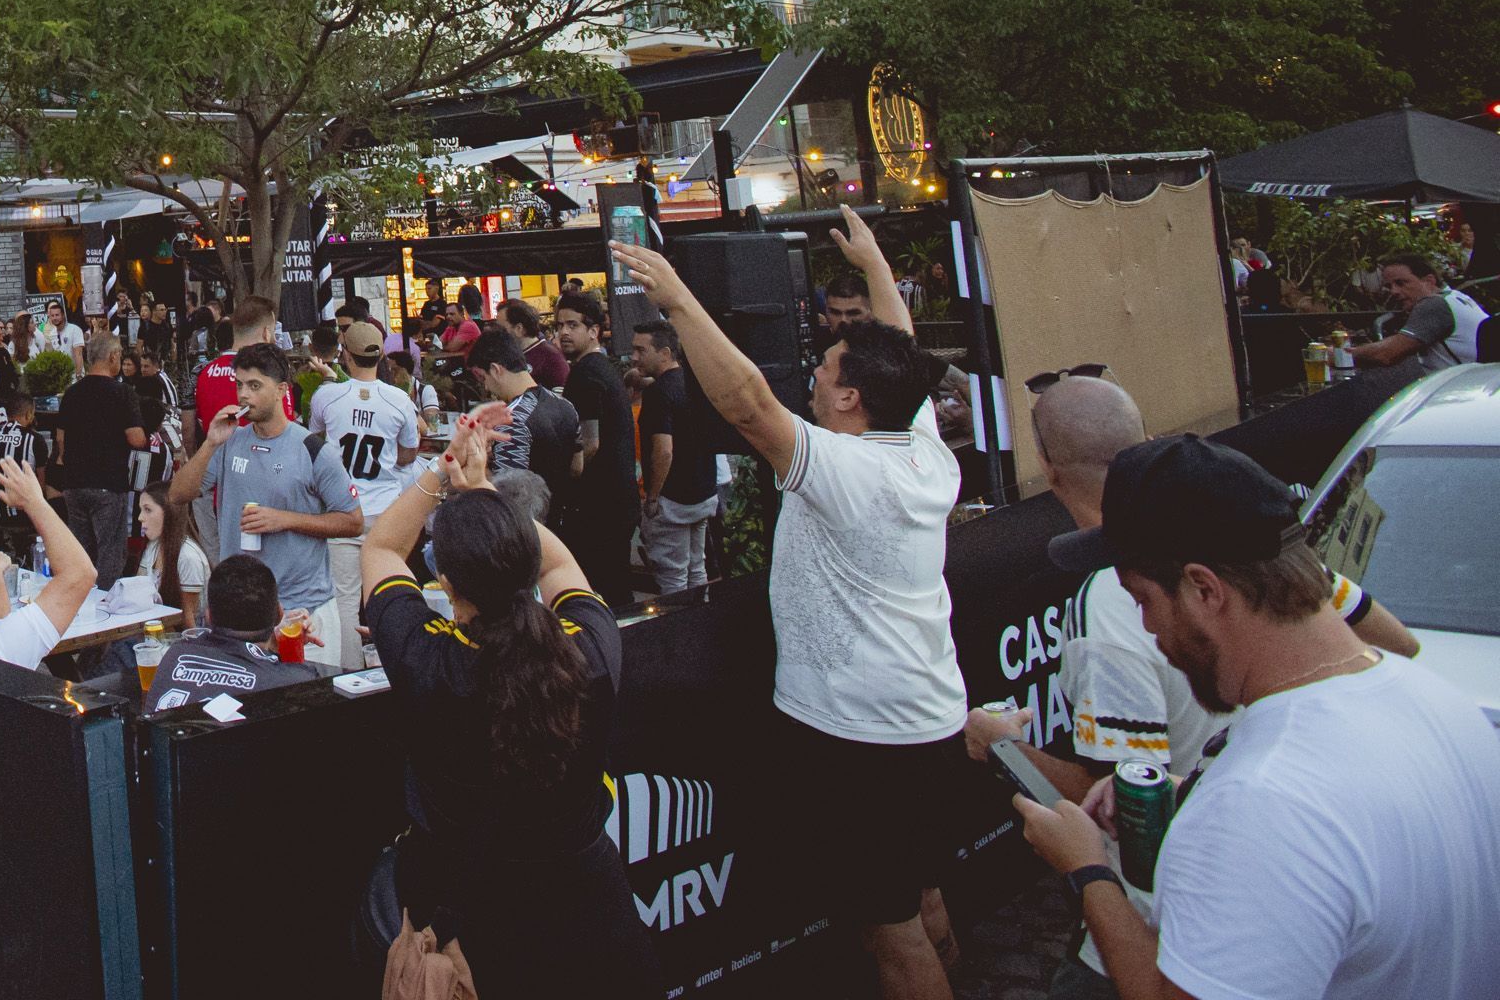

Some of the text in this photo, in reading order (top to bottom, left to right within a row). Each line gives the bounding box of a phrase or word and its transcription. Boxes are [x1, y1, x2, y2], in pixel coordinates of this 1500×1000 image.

[1246, 182, 1332, 197] BULLER
[286, 240, 311, 253] UTAR
[281, 270, 313, 283] LUTAR
[352, 408, 376, 428] FIAT
[232, 455, 249, 474] FIAT
[338, 432, 385, 481] 10
[1000, 597, 1072, 681] CAS
[173, 665, 256, 689] Camponesa
[974, 820, 1014, 850] CASA DA MASSA
[632, 852, 735, 932] MRV
[804, 918, 830, 937] AMSTEL
